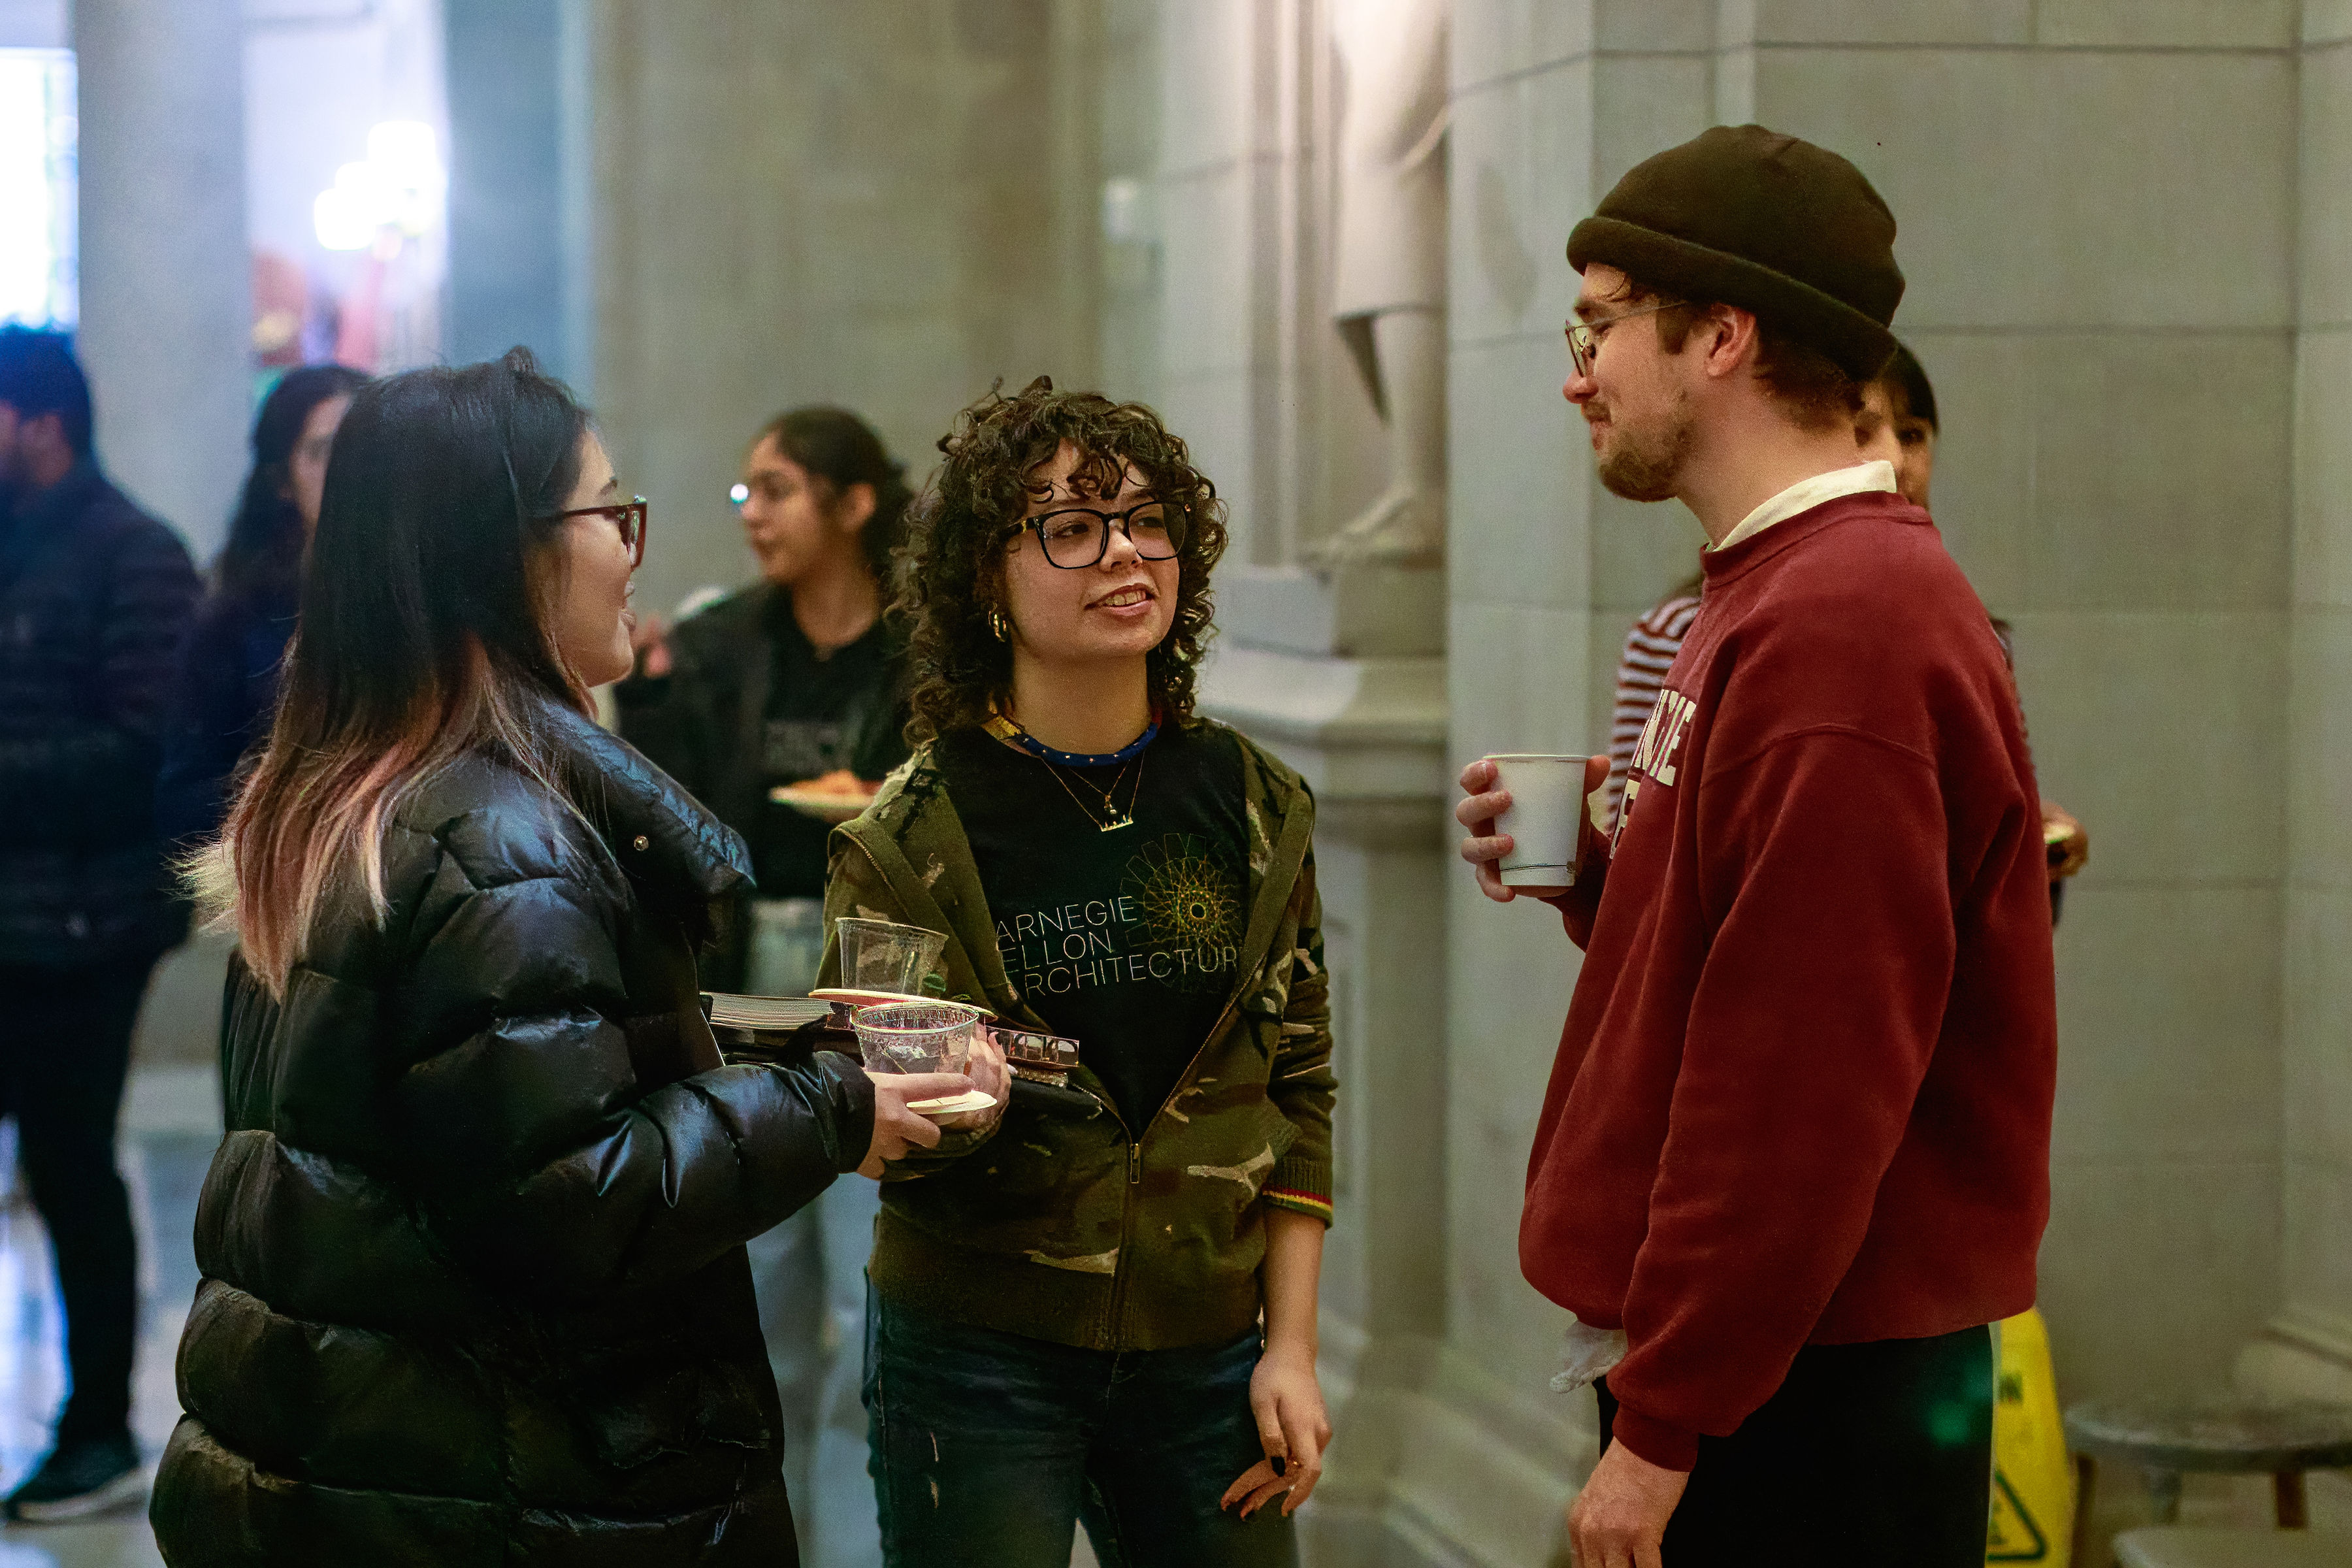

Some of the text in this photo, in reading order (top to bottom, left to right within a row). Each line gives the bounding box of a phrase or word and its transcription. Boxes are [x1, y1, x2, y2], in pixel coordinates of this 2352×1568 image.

[996, 896, 1137, 943] ARNEGIE
[998, 929, 1113, 973] ELLON
[1024, 945, 1238, 999] RCHITECTUR
